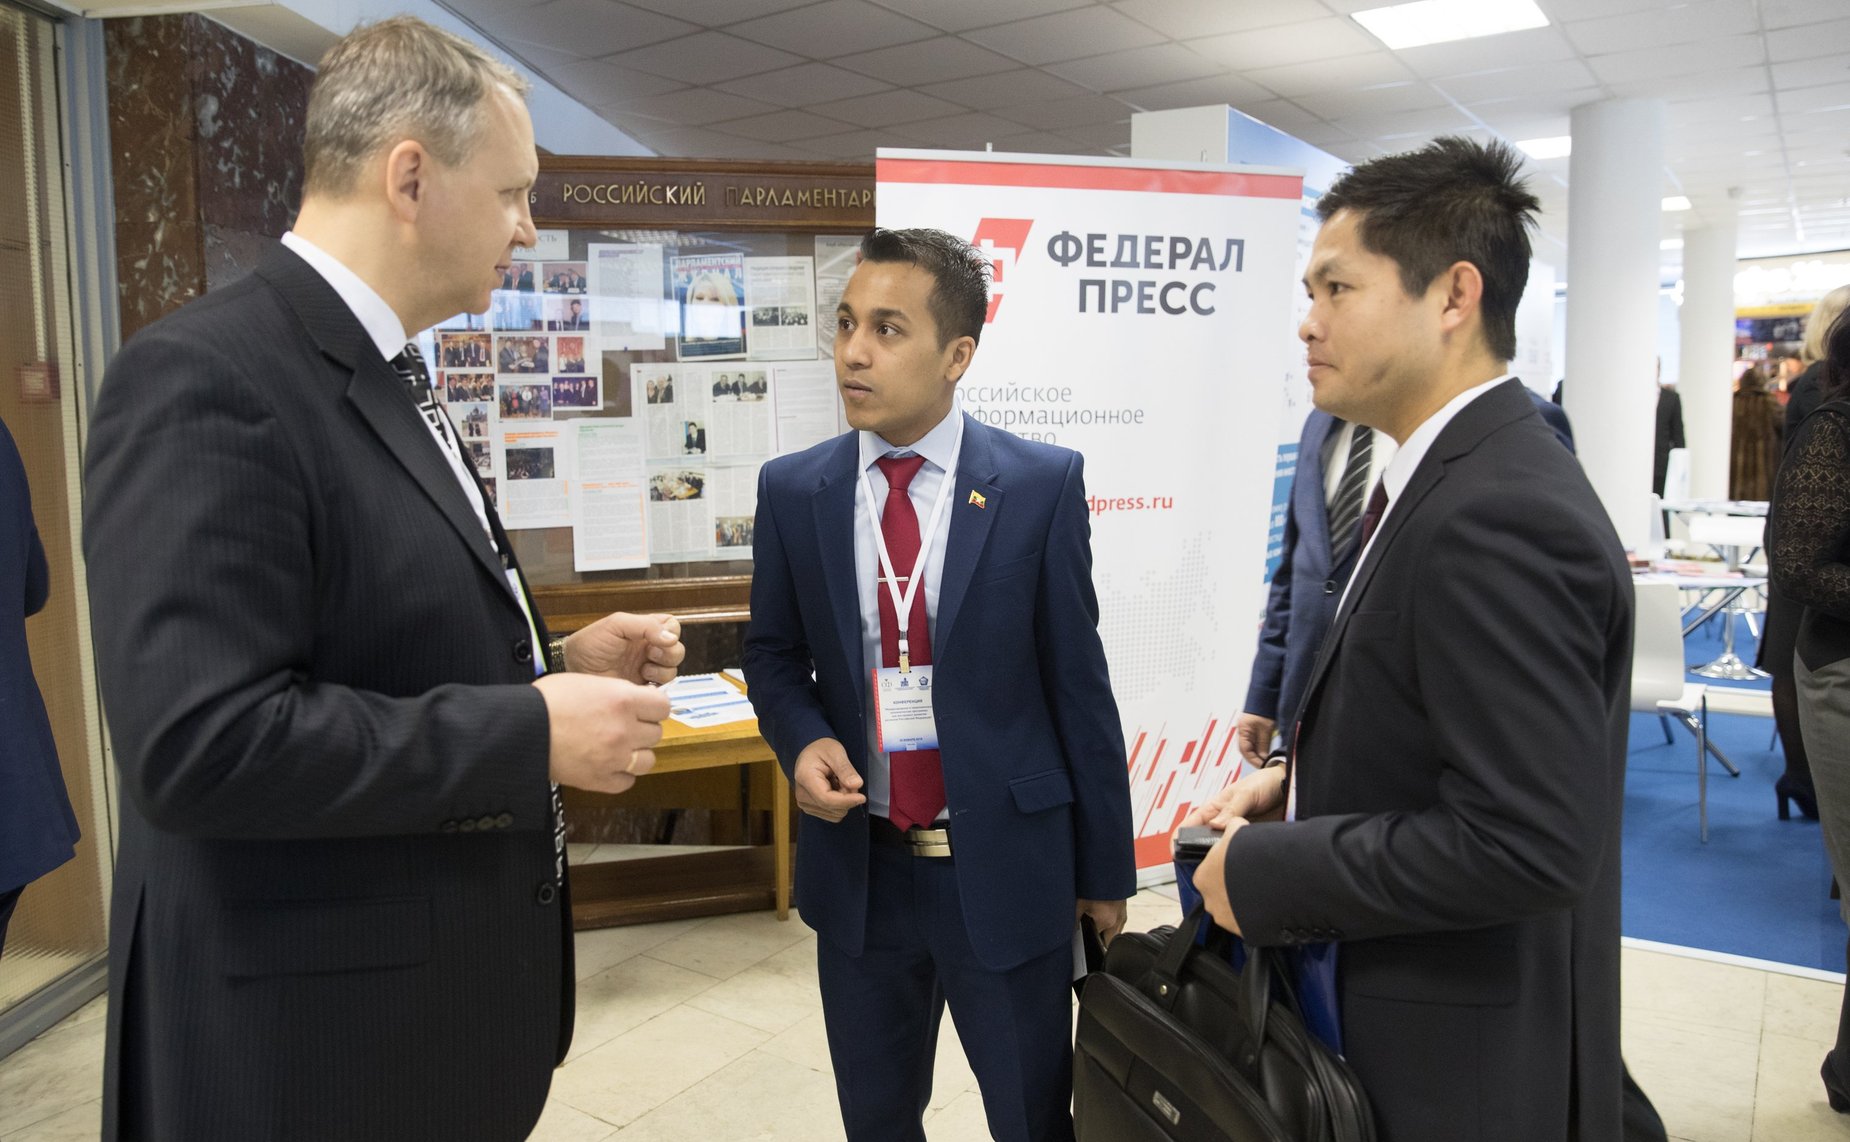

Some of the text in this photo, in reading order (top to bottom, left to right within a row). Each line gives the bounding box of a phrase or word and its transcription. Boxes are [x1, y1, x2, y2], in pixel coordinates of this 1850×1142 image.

[563, 181, 706, 205] РОССИЙСКИЙ
[725, 186, 876, 208] ПАРЛАМЕНТАР
[1047, 230, 1245, 273] ФЕДЕРАЛ
[1078, 279, 1217, 316] ПРЕСС
[967, 405, 1144, 428] формационное
